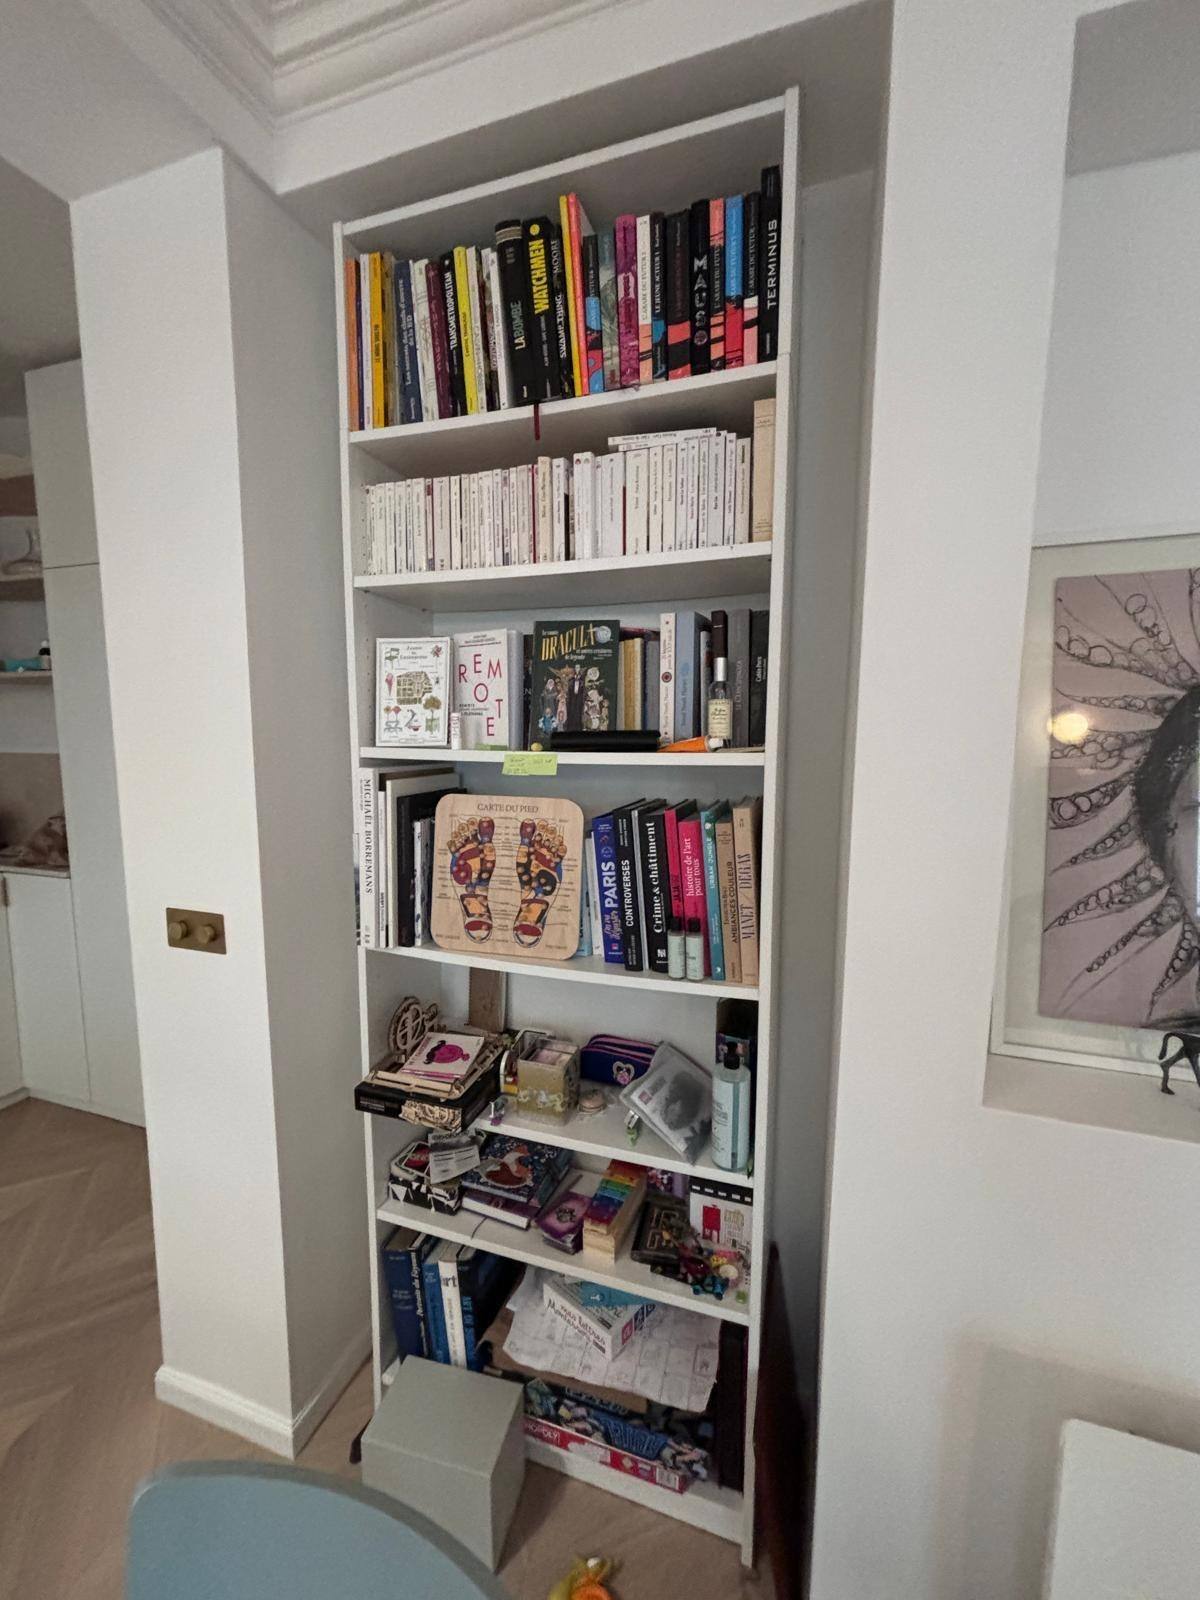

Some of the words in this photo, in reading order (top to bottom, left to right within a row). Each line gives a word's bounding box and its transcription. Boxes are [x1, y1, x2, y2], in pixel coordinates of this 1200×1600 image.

[529, 239, 549, 315] WATCHMEN
[767, 219, 777, 310] TERMINUS
[694, 254, 707, 327] MAUS
[444, 271, 458, 350] TRANSMETROPOLITAN
[510, 300, 525, 338] BOMBE
[514, 335, 526, 350] LA
[477, 803, 504, 812] CARTE
[505, 805, 519, 813] DU
[520, 805, 540, 813] PIED
[364, 830, 373, 894] BORREMANS
[645, 821, 660, 886] châtiment
[682, 837, 691, 856] l'art
[684, 857, 692, 866] de
[601, 861, 619, 908] PARIS
[685, 867, 695, 897] histoire
[693, 858, 701, 876] tous
[726, 861, 735, 897] COULEUR
[736, 853, 752, 889] DEGAS
[621, 859, 634, 927] CONTROVERSES
[654, 886, 660, 895] &
[695, 877, 703, 896] pour
[652, 895, 663, 933] Crime
[729, 899, 739, 944] AMBIANCES
[739, 903, 755, 940] MANET
